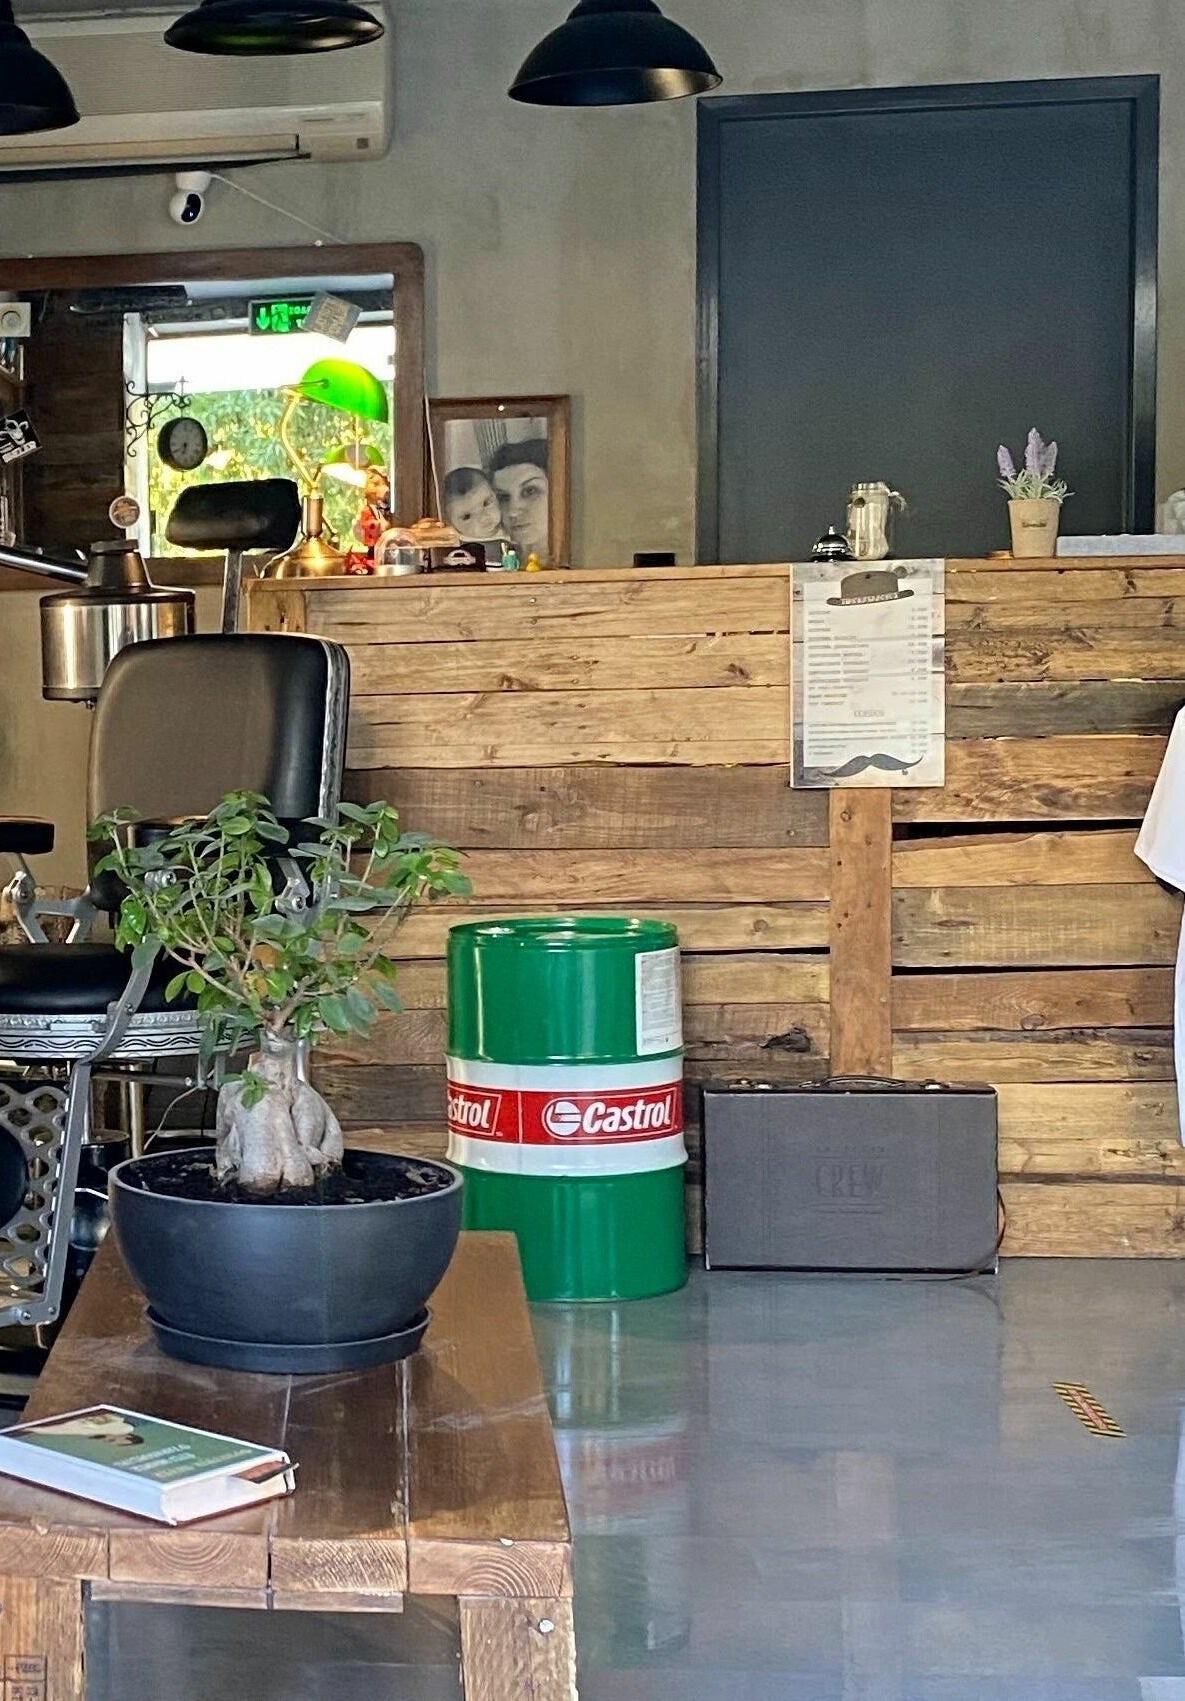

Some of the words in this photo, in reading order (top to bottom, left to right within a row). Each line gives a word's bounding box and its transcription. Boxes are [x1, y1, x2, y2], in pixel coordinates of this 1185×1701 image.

[447, 1093, 491, 1130] astrol
[582, 1094, 672, 1134] Castrol
[815, 1163, 886, 1198] CREW
